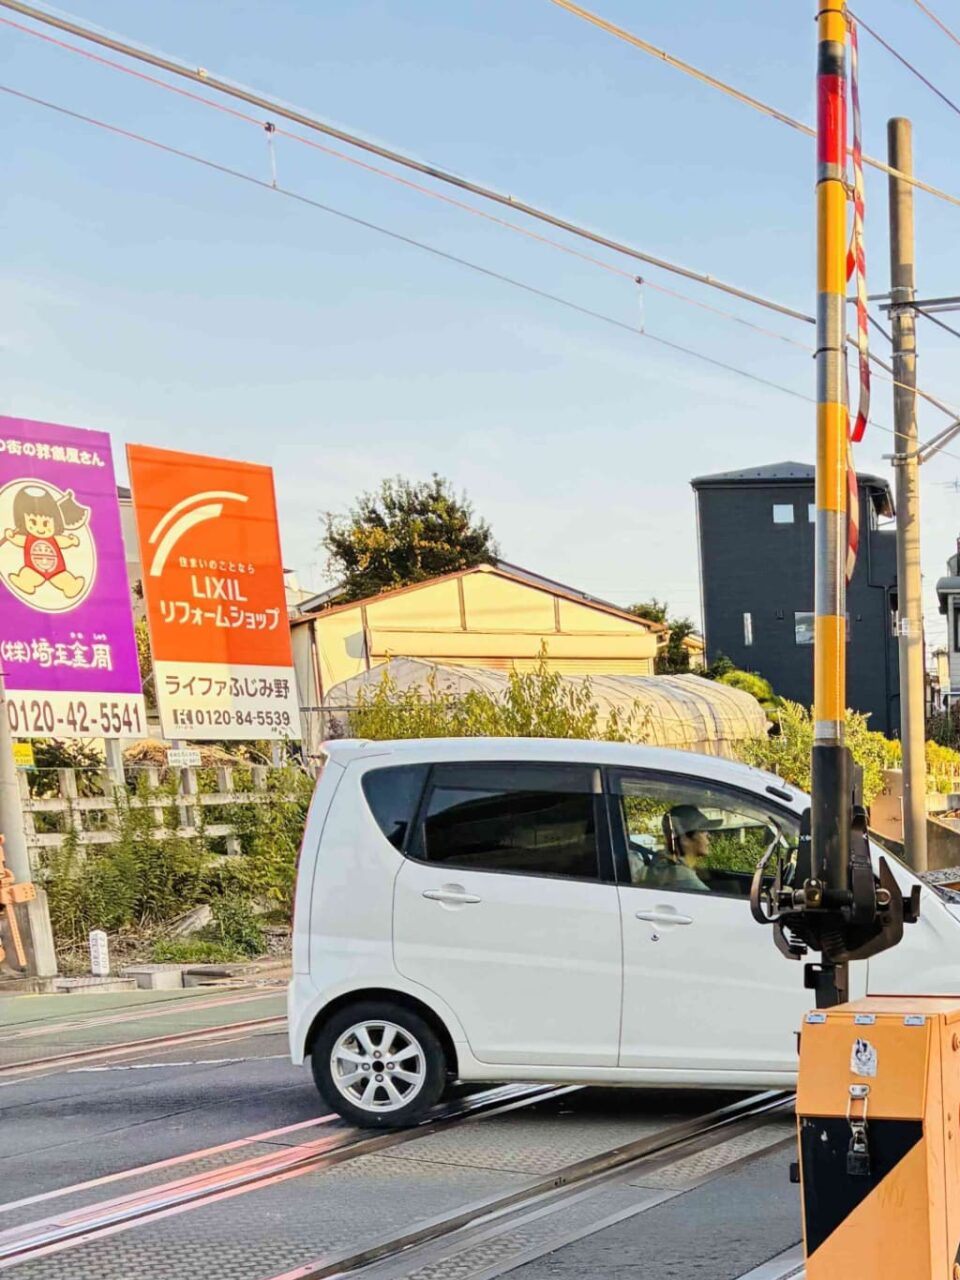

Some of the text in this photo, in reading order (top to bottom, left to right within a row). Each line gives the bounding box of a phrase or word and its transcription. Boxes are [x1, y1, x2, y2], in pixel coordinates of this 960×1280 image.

[191, 575, 248, 602] LIXIL
[160, 600, 281, 631] リフォームショップ
[165, 675, 290, 700] ライファふじみ野
[6, 699, 142, 733] 0120-42-5541
[195, 709, 291, 727] 0120-84-5539
